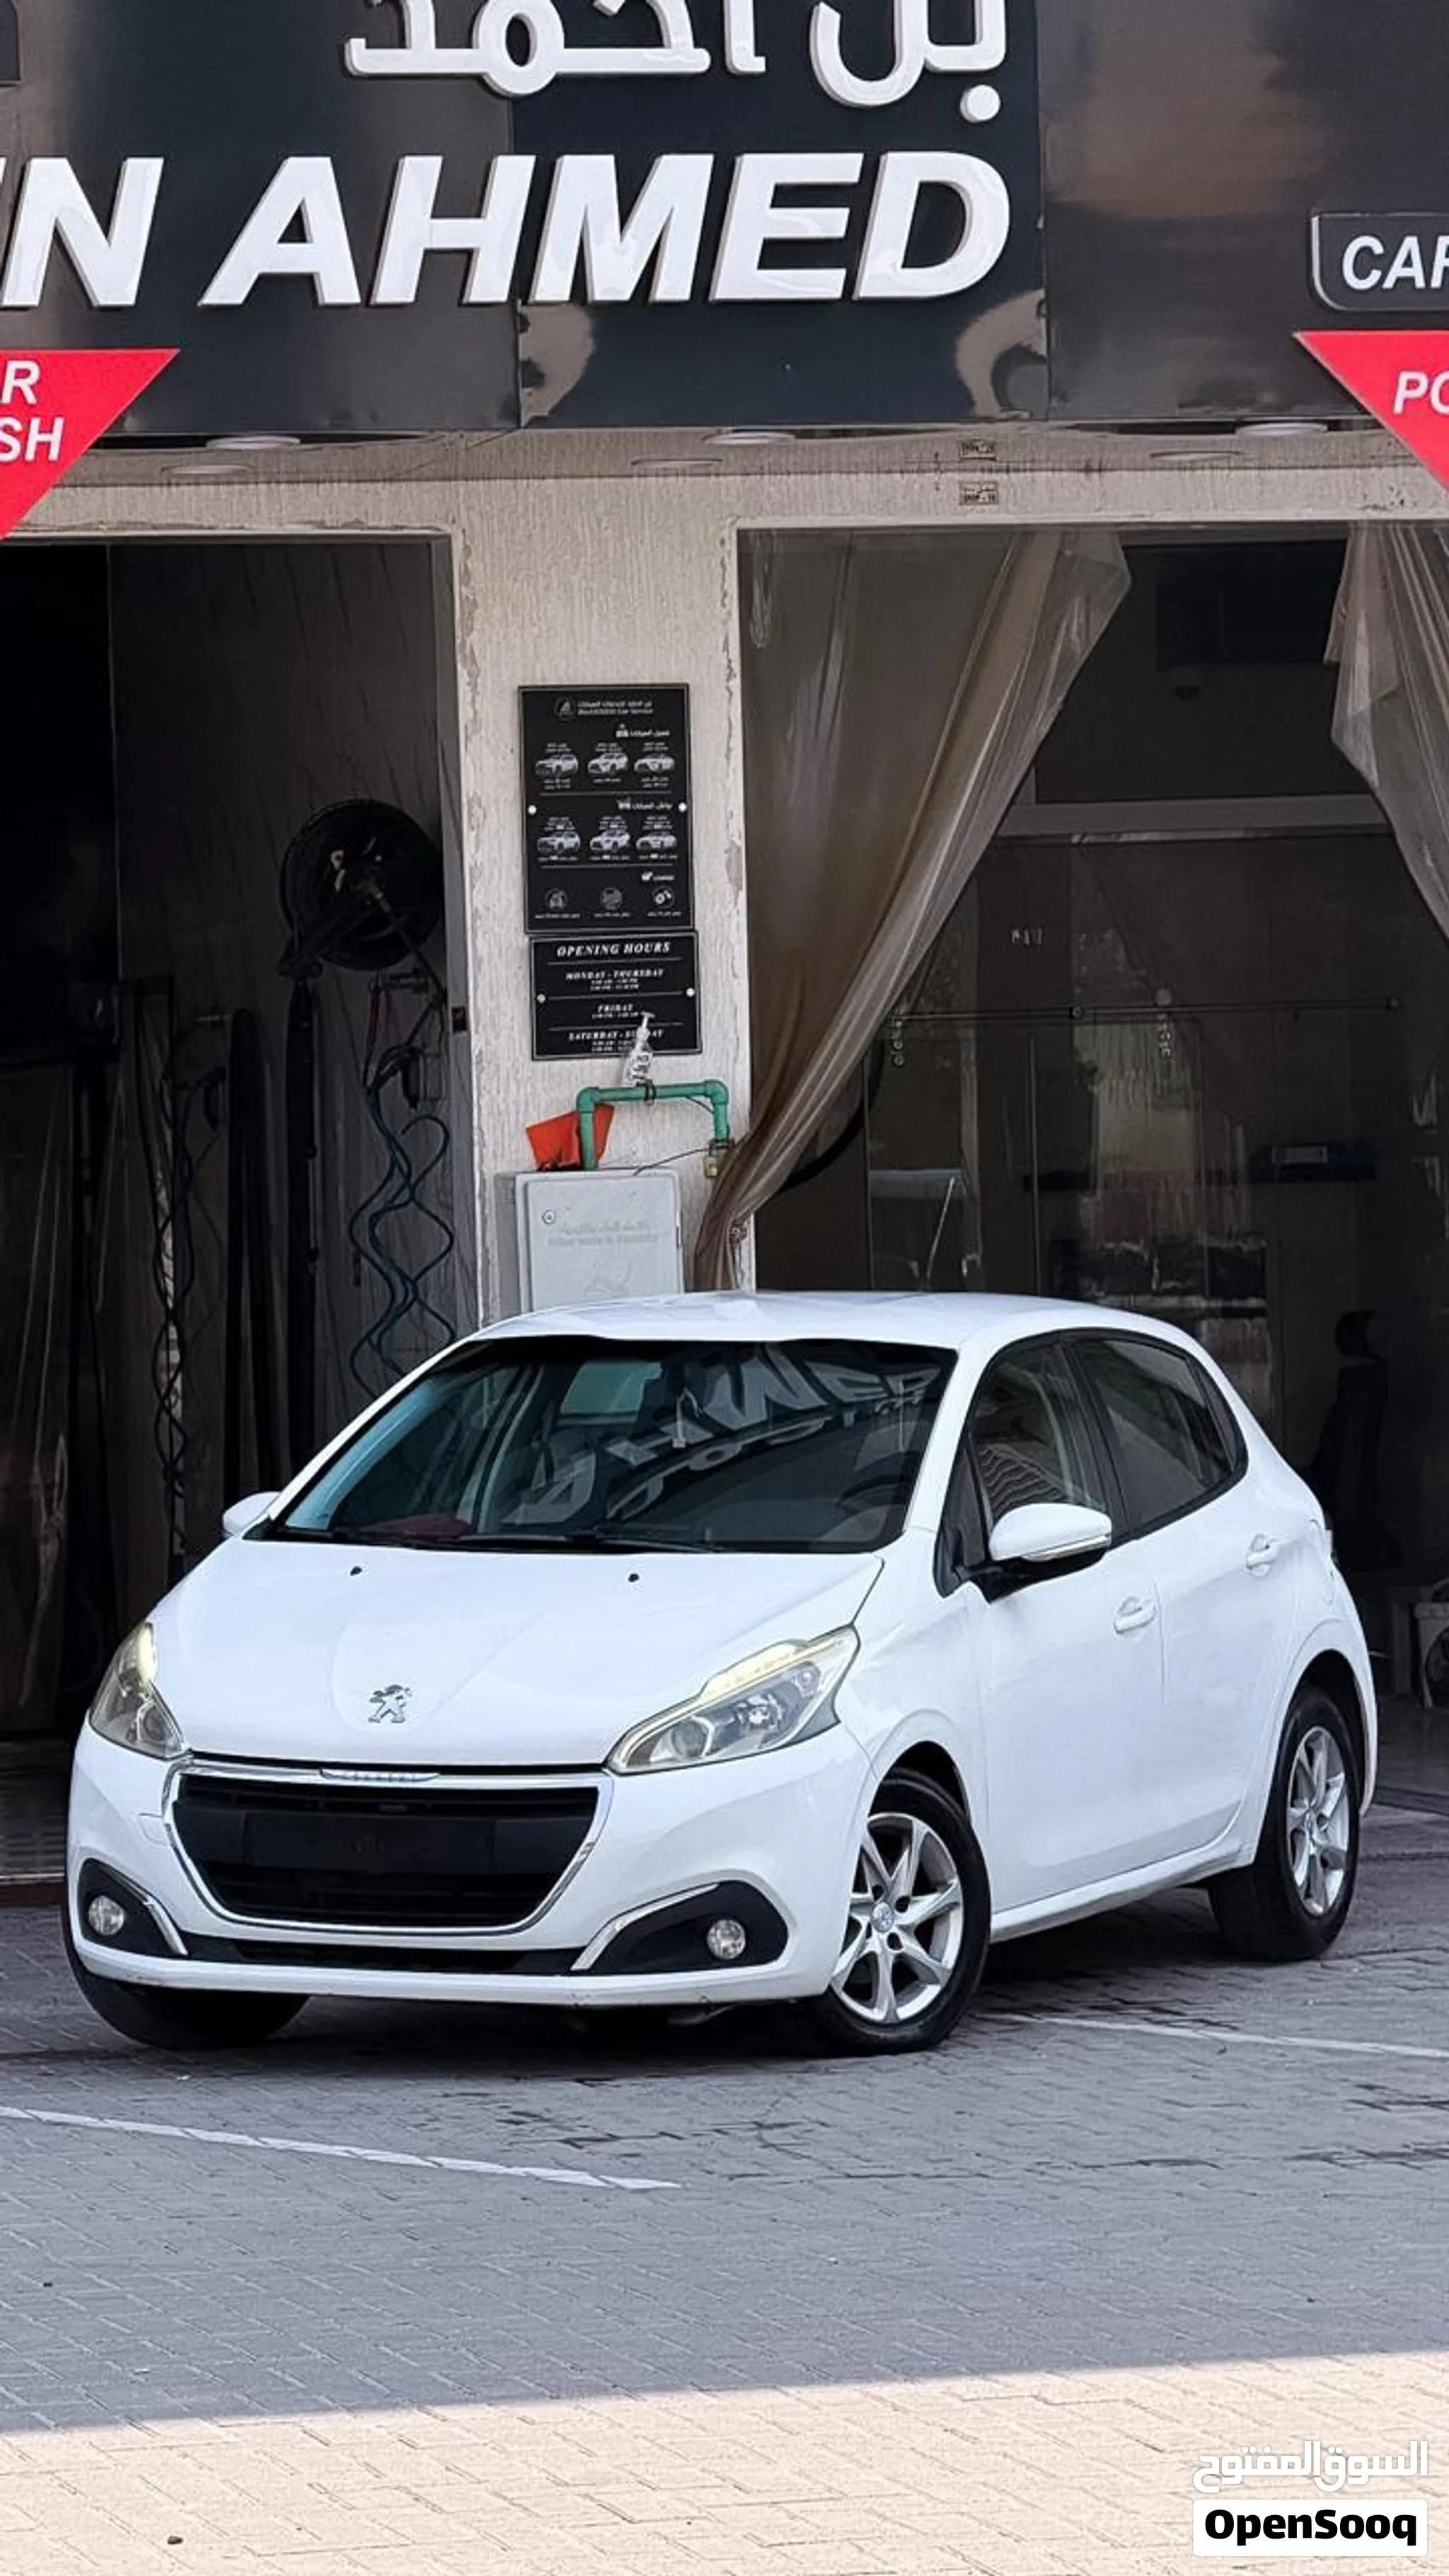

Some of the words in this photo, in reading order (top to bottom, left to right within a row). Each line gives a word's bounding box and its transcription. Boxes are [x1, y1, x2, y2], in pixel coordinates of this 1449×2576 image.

[0, 156, 164, 307] N
[198, 151, 1010, 306] AHMED
[557, 943, 620, 957] OPENING
[623, 942, 671, 954] HOURS
